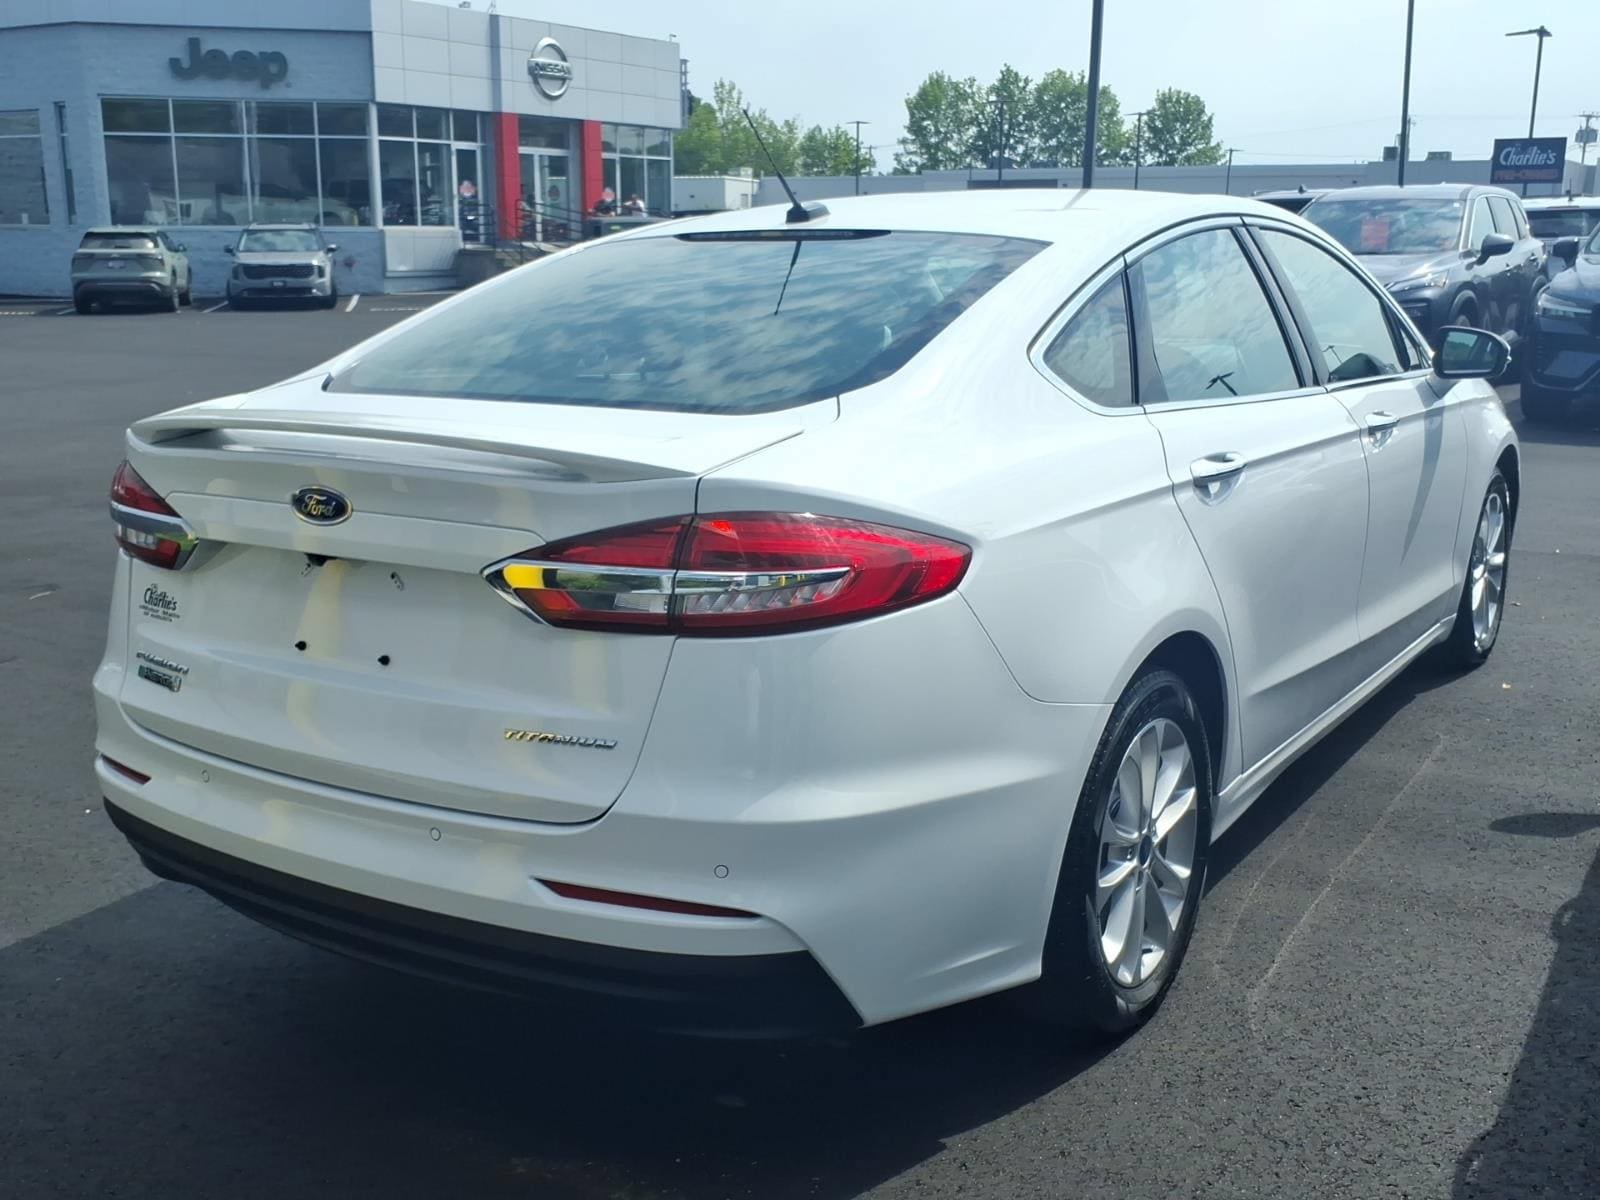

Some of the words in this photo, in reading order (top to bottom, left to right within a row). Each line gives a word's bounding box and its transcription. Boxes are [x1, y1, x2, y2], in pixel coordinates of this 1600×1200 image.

[168, 36, 288, 90] Jeep
[533, 62, 571, 78] NISSAN
[1500, 145, 1556, 166] Charlie's
[302, 494, 337, 516] Ford
[143, 587, 178, 612] Charlie's
[504, 729, 618, 750] TITANIUM
